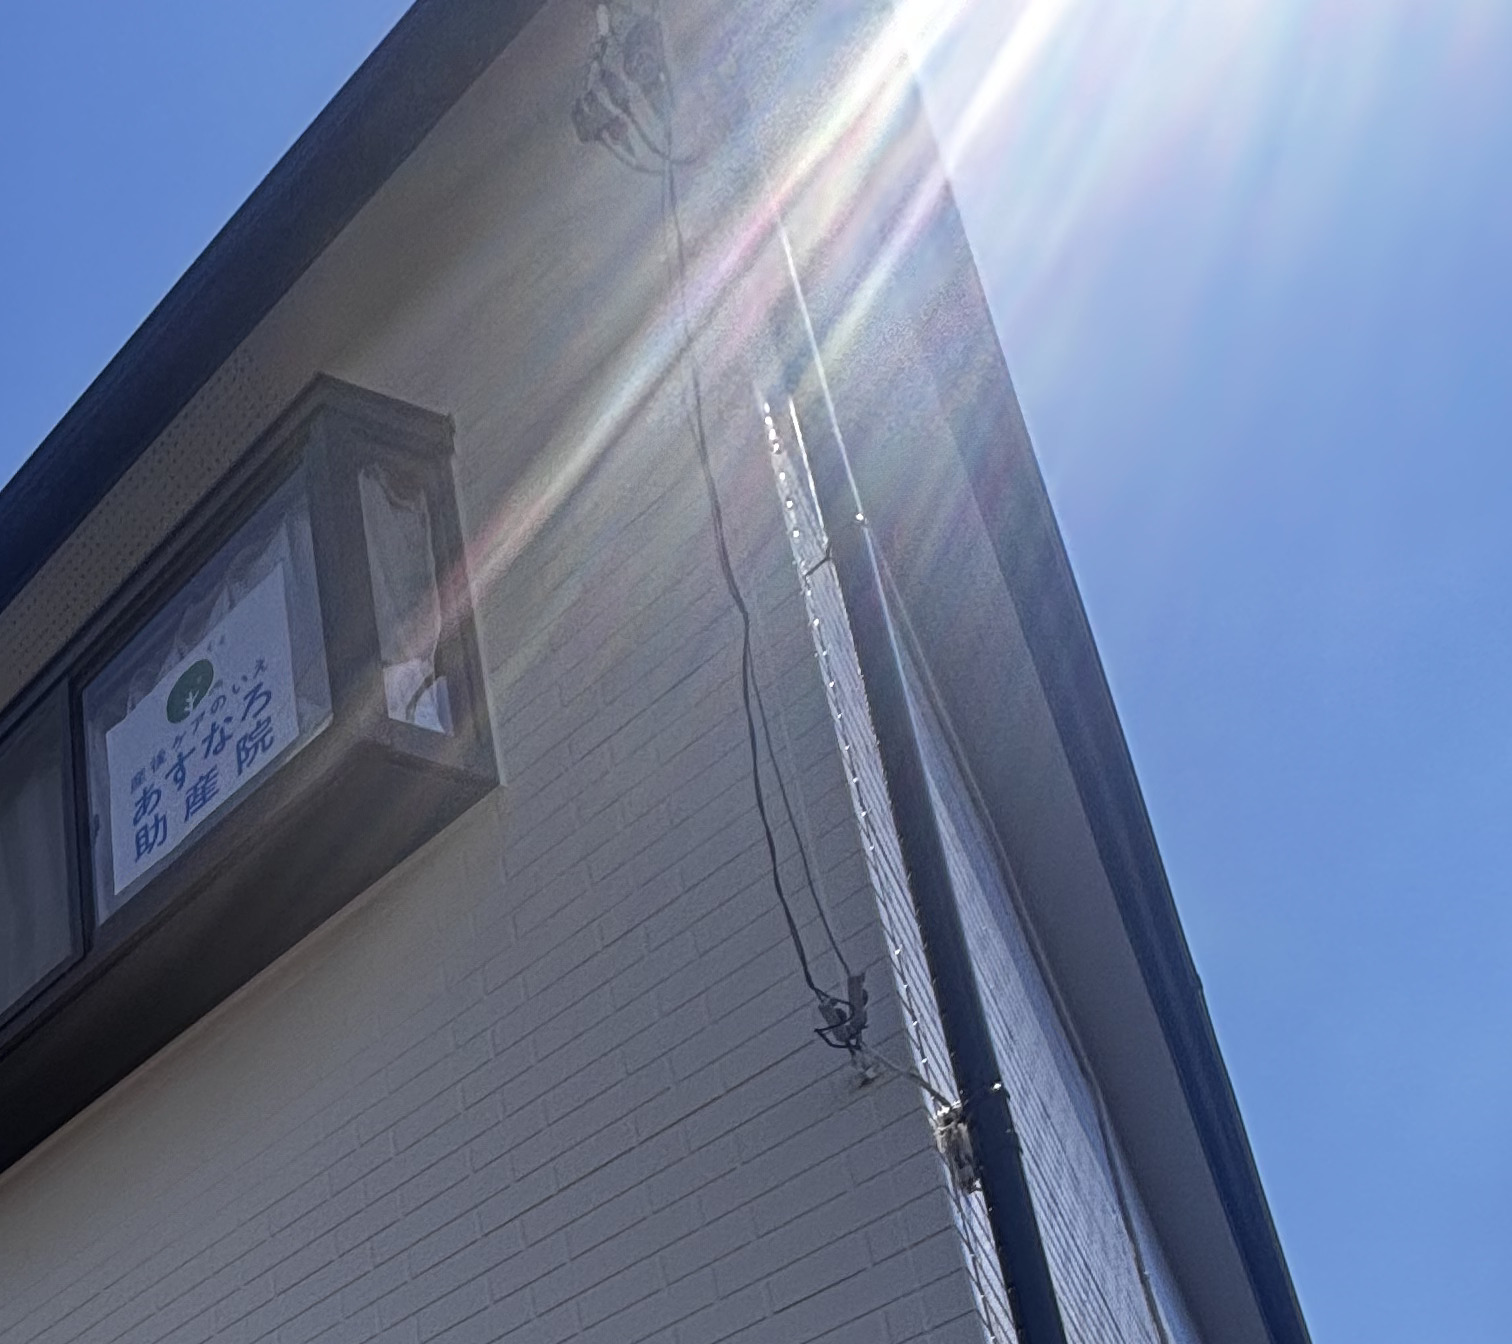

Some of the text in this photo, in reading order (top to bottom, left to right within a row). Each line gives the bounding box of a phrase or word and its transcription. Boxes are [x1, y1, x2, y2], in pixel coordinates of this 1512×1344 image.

[132, 681, 272, 827] あすなろ
[133, 714, 274, 864] 助産院
